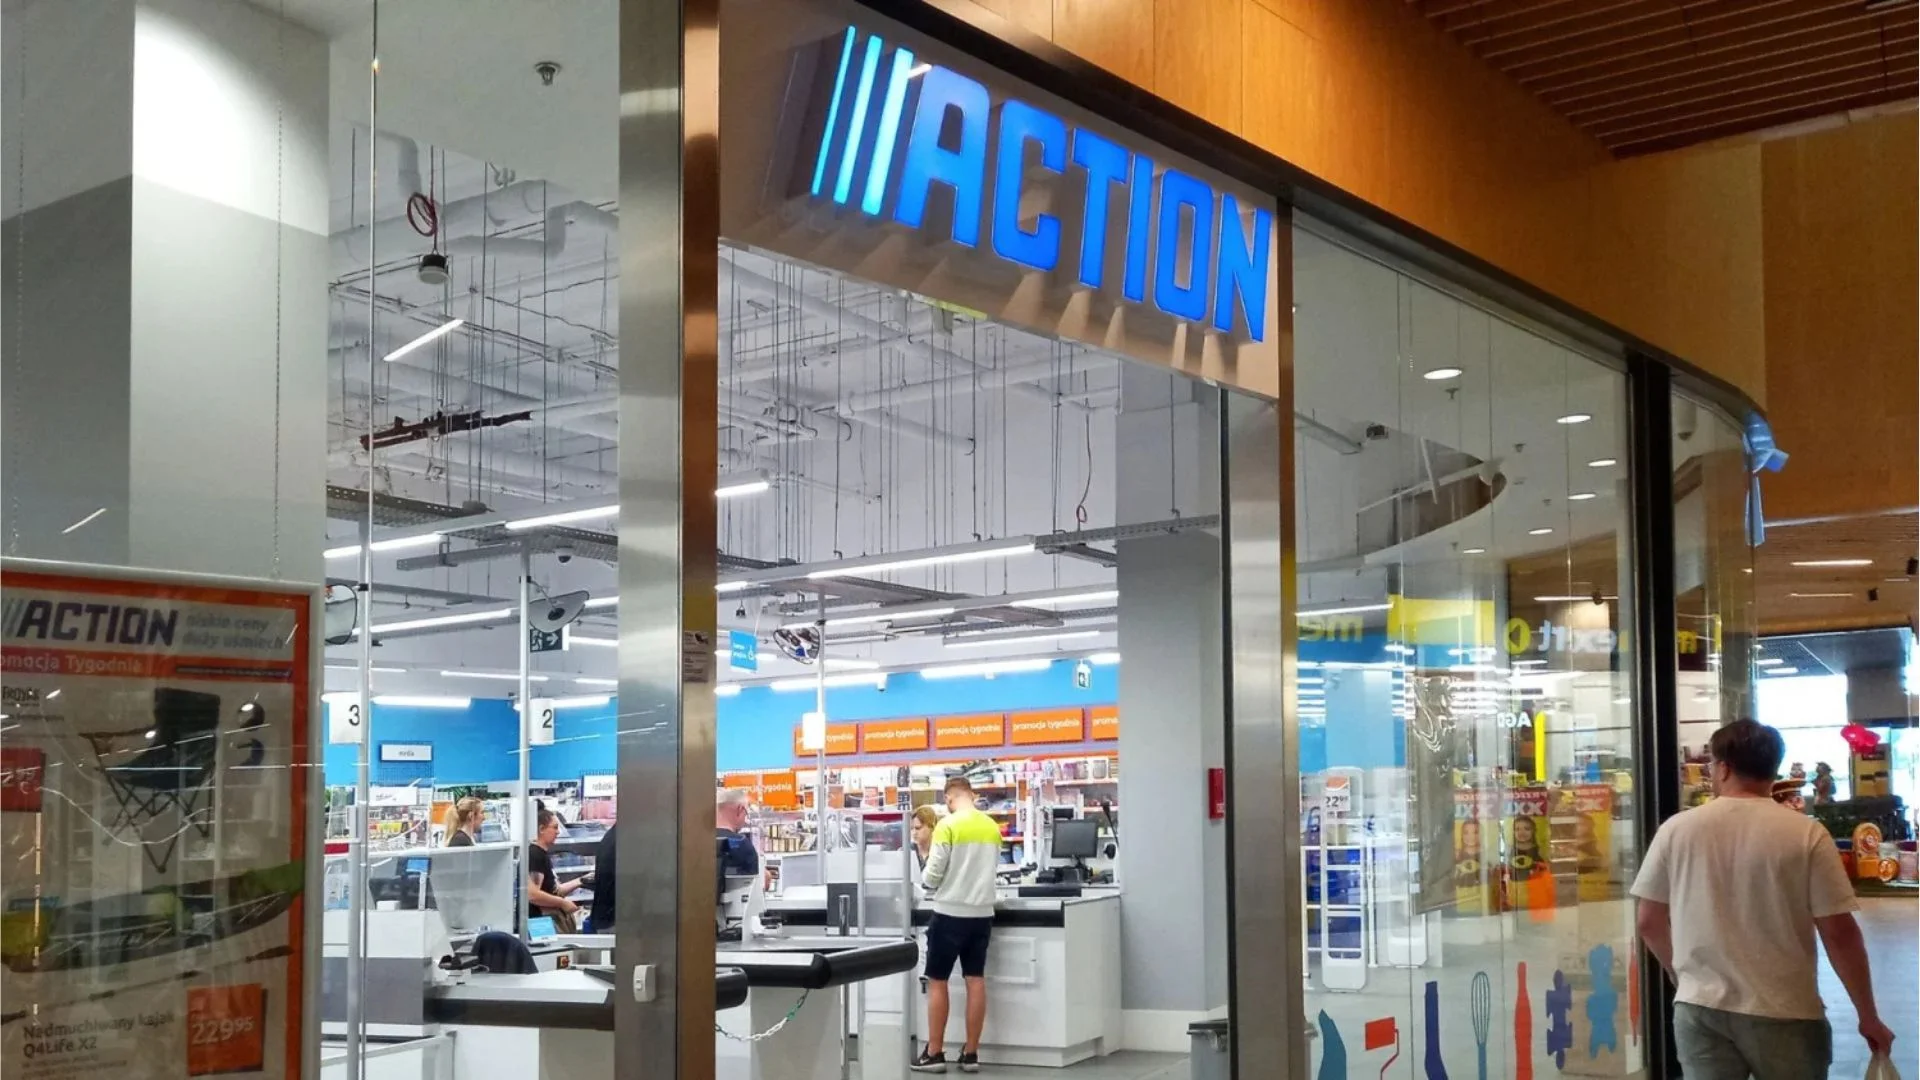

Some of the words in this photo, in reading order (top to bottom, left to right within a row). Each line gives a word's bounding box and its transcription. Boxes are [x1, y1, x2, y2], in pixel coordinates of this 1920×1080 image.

[893, 64, 1272, 343] ACTION
[16, 600, 179, 647] ACTION
[65, 654, 144, 674] Tygodnia
[348, 704, 360, 727] 3
[542, 709, 553, 729] 2
[1012, 720, 1047, 732] promocja
[1047, 718, 1080, 730] tygodnia
[936, 727, 969, 737] promocja
[23, 1017, 135, 1040] Nadmuchiwany
[79, 1036, 97, 1050] X2
